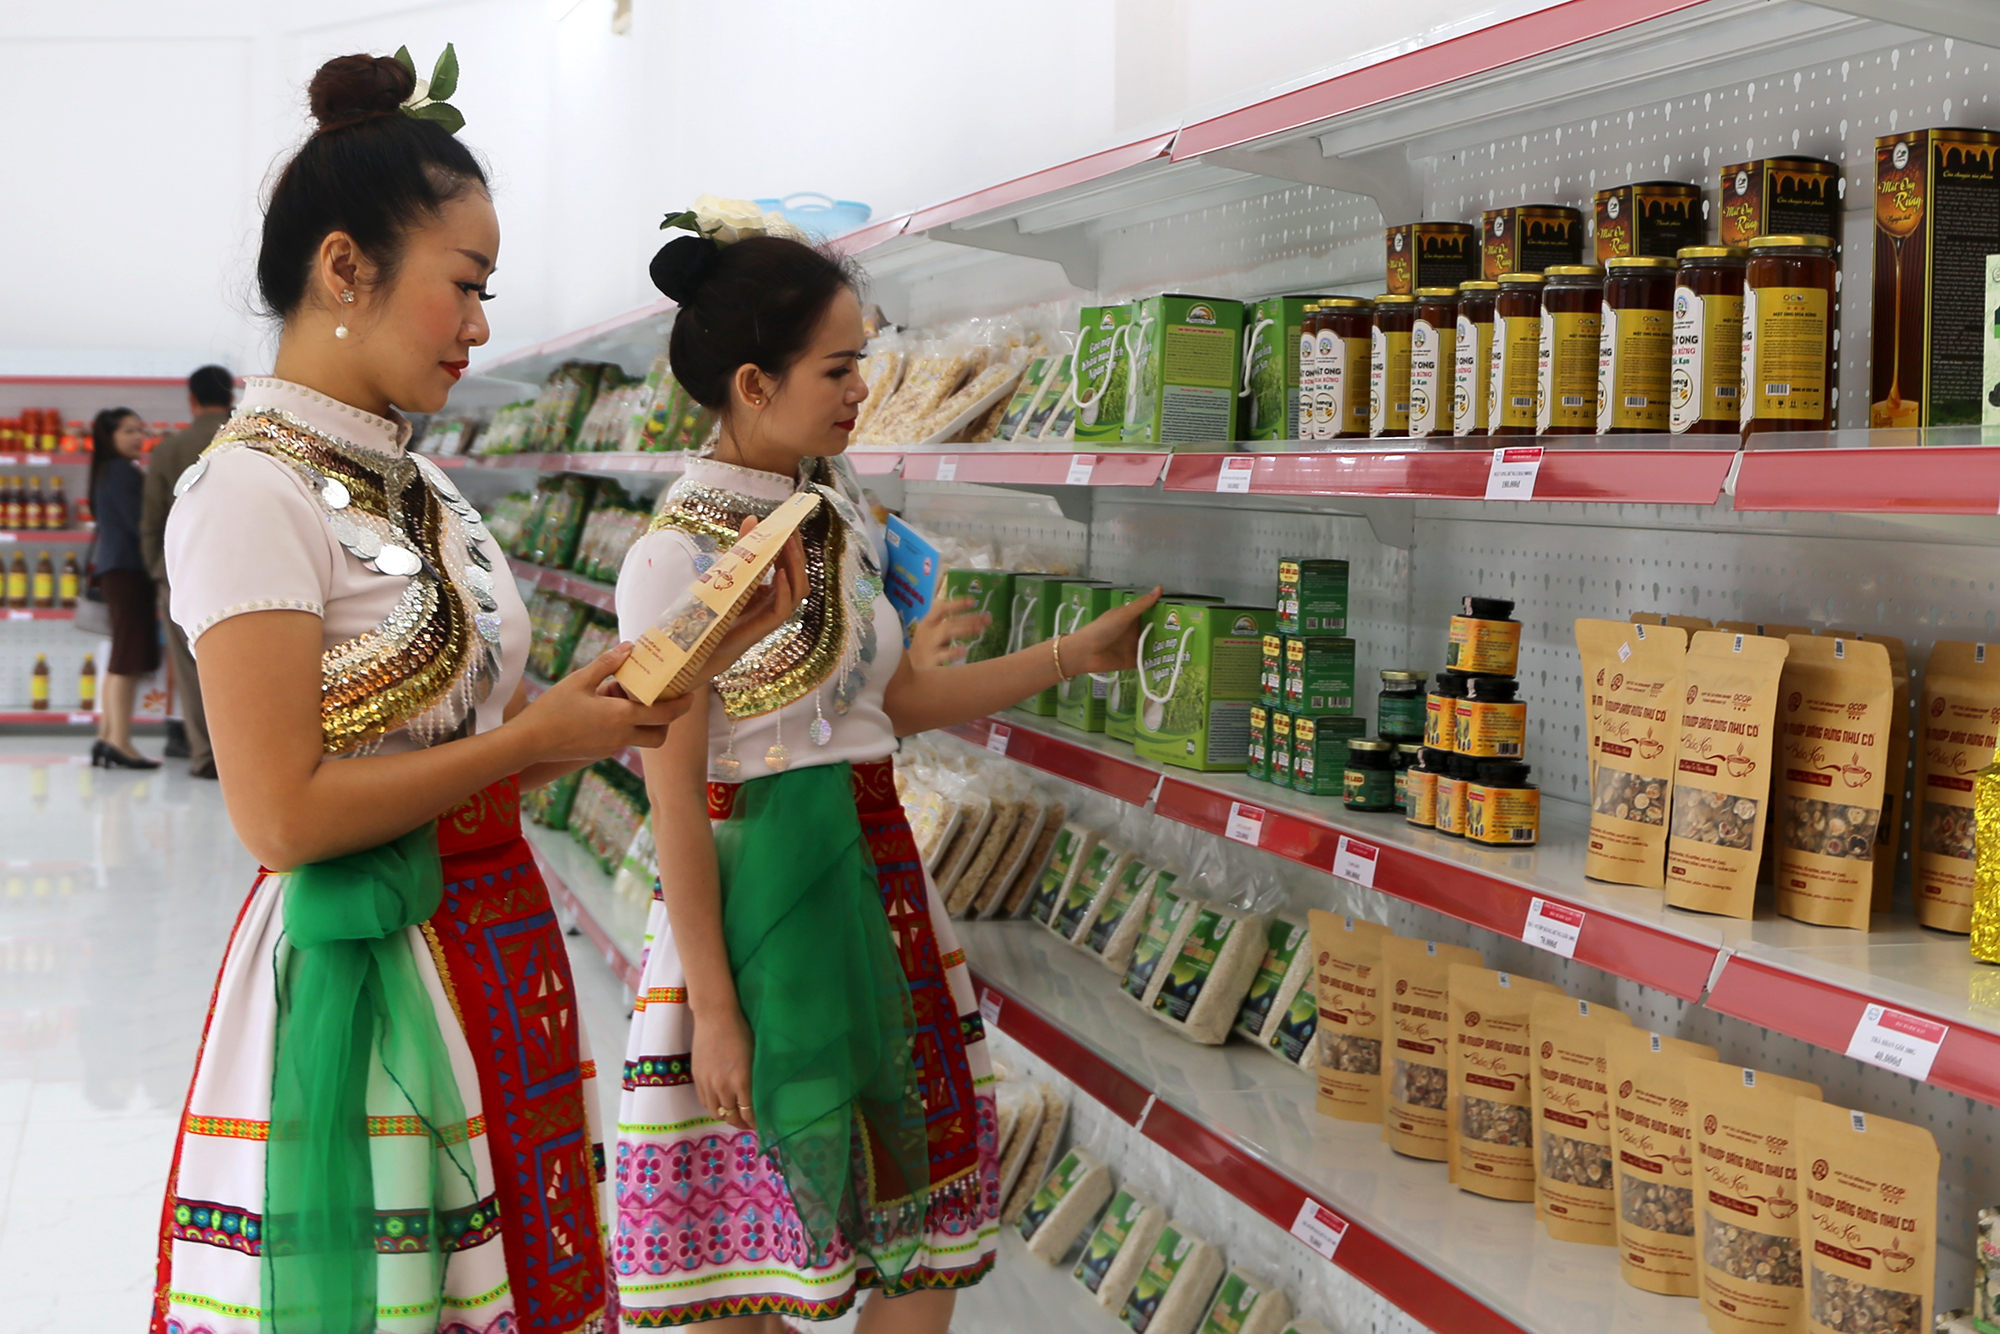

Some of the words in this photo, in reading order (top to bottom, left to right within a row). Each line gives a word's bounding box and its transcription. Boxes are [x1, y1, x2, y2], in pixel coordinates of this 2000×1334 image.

[1728, 721, 1746, 735] NHƯ
[1747, 723, 1761, 737] CỐ
[1842, 730, 1861, 744] NHƯ
[1861, 732, 1876, 746] CỐ
[1984, 735, 1996, 748] NH
